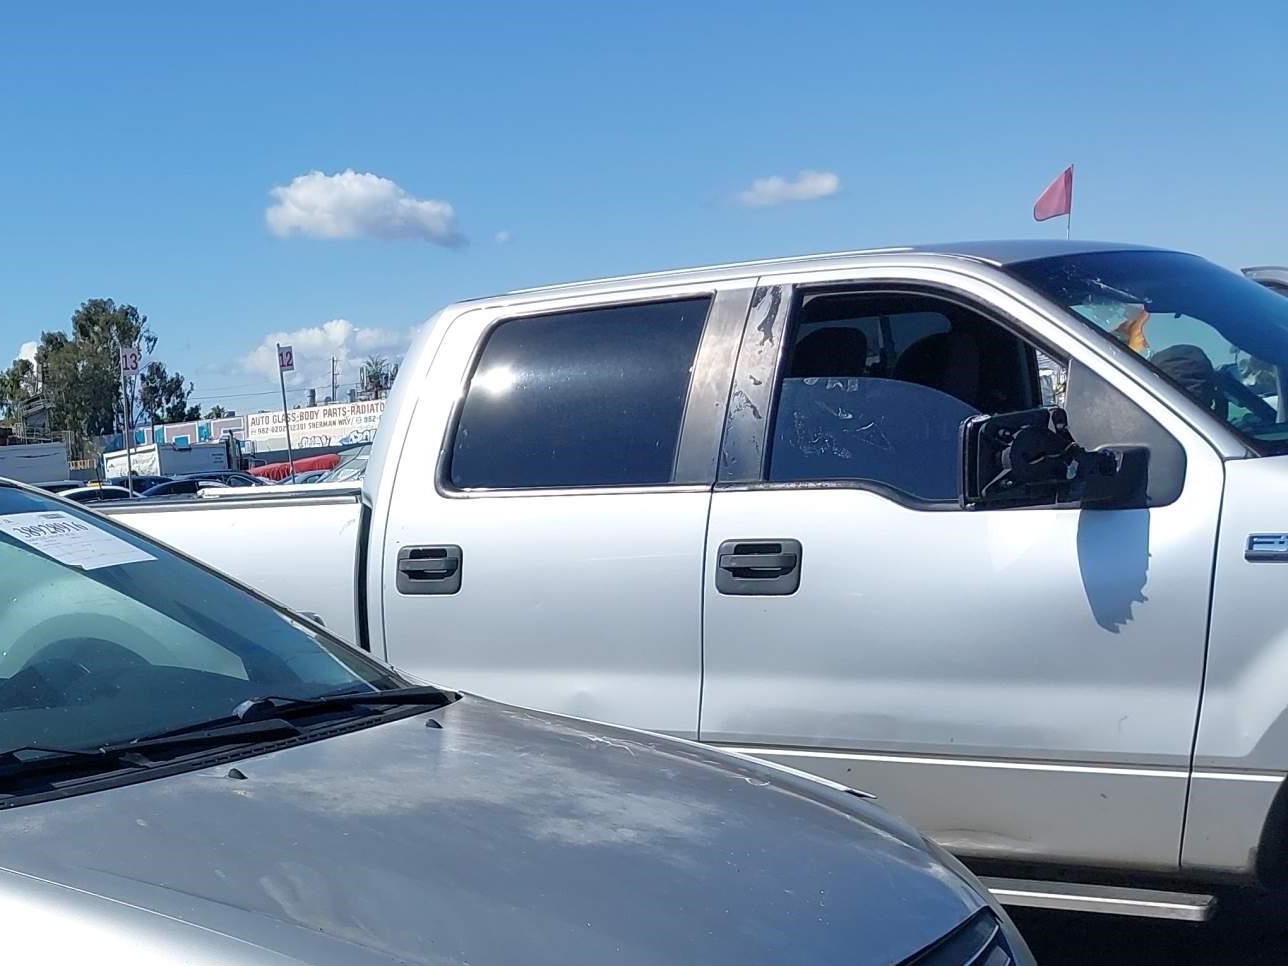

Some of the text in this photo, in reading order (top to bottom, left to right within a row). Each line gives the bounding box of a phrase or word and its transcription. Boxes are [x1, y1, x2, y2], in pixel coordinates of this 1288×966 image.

[122, 353, 138, 370] 13
[279, 351, 293, 367] 12
[251, 415, 270, 426] AUTO
[308, 418, 337, 429] SHERMAN
